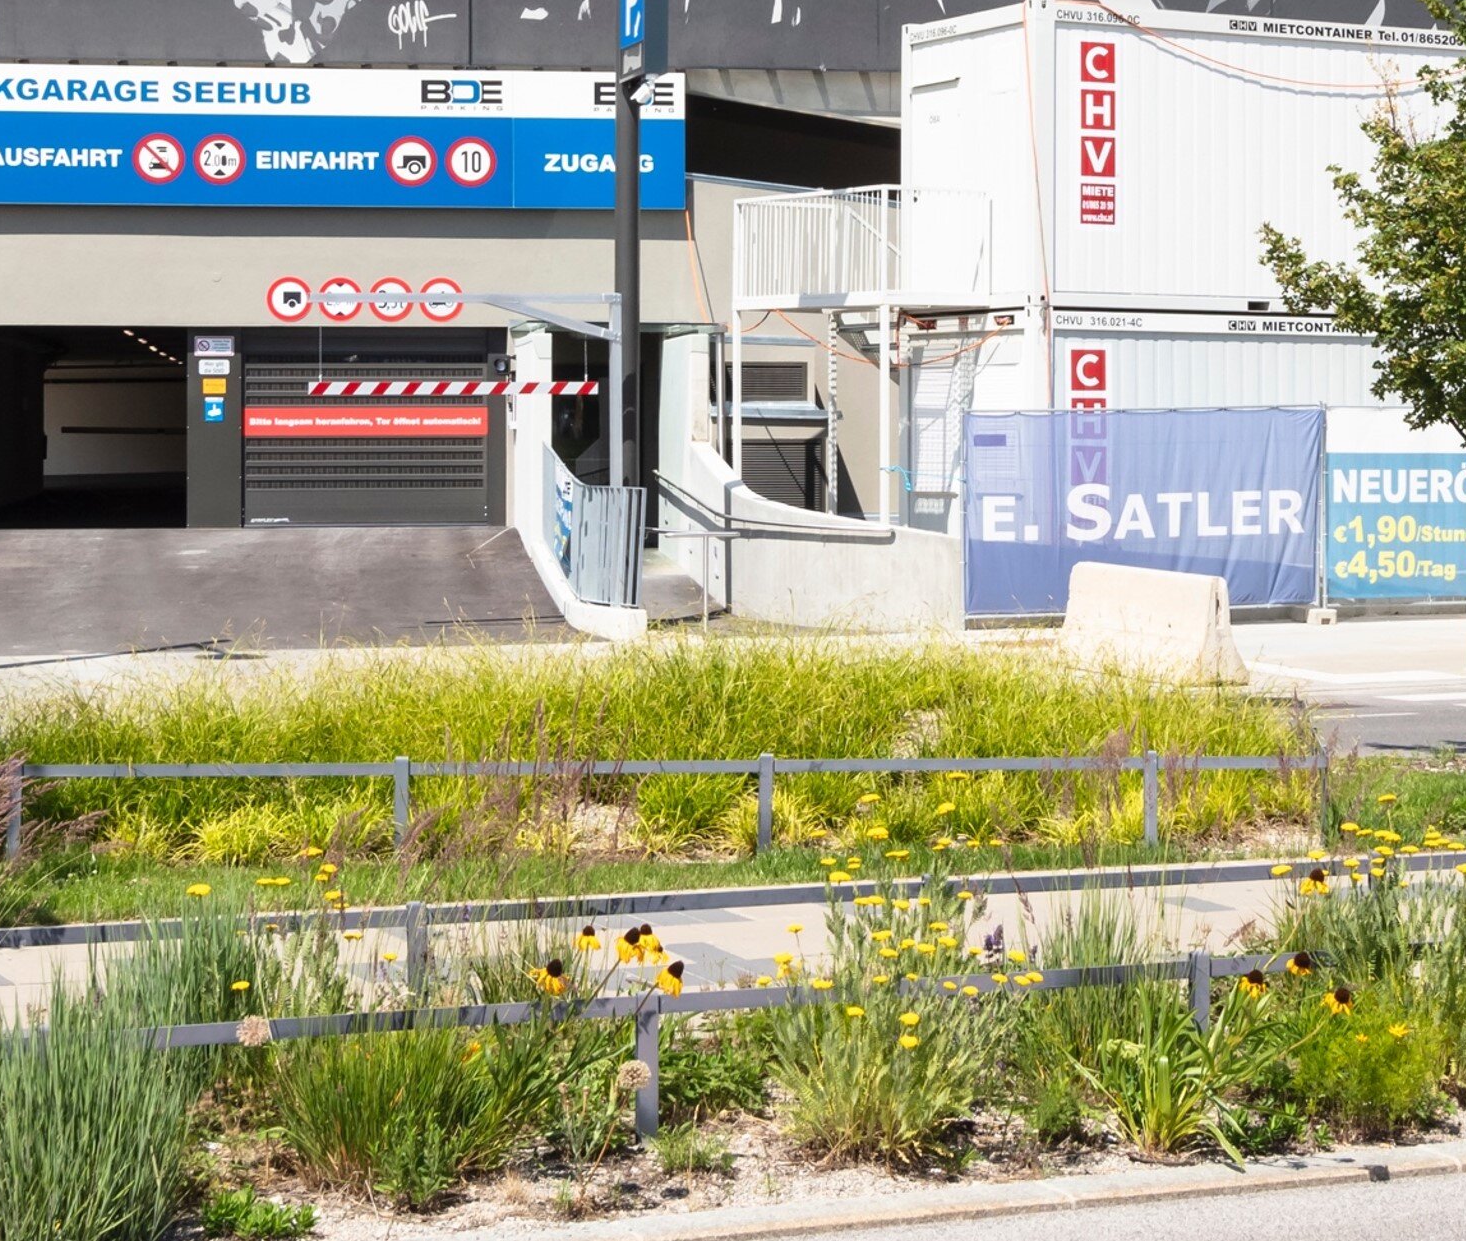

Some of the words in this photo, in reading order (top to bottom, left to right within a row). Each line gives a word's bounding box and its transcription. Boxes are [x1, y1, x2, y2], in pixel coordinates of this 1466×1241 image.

[1056, 9, 1084, 21] CHVU
[1263, 23, 1372, 40] MIETCONTAINER
[173, 81, 311, 104] SEEHUB
[256, 151, 379, 171] EINFAHRT
[461, 151, 482, 173] 10
[544, 153, 654, 172] ZUGAG
[1082, 185, 1114, 197] MIETE
[1056, 315, 1082, 325] CHVU
[1090, 317, 1142, 327] 316.021-4C
[249, 417, 272, 426] Bitte
[376, 417, 391, 425] Tor
[983, 496, 1039, 541] E.
